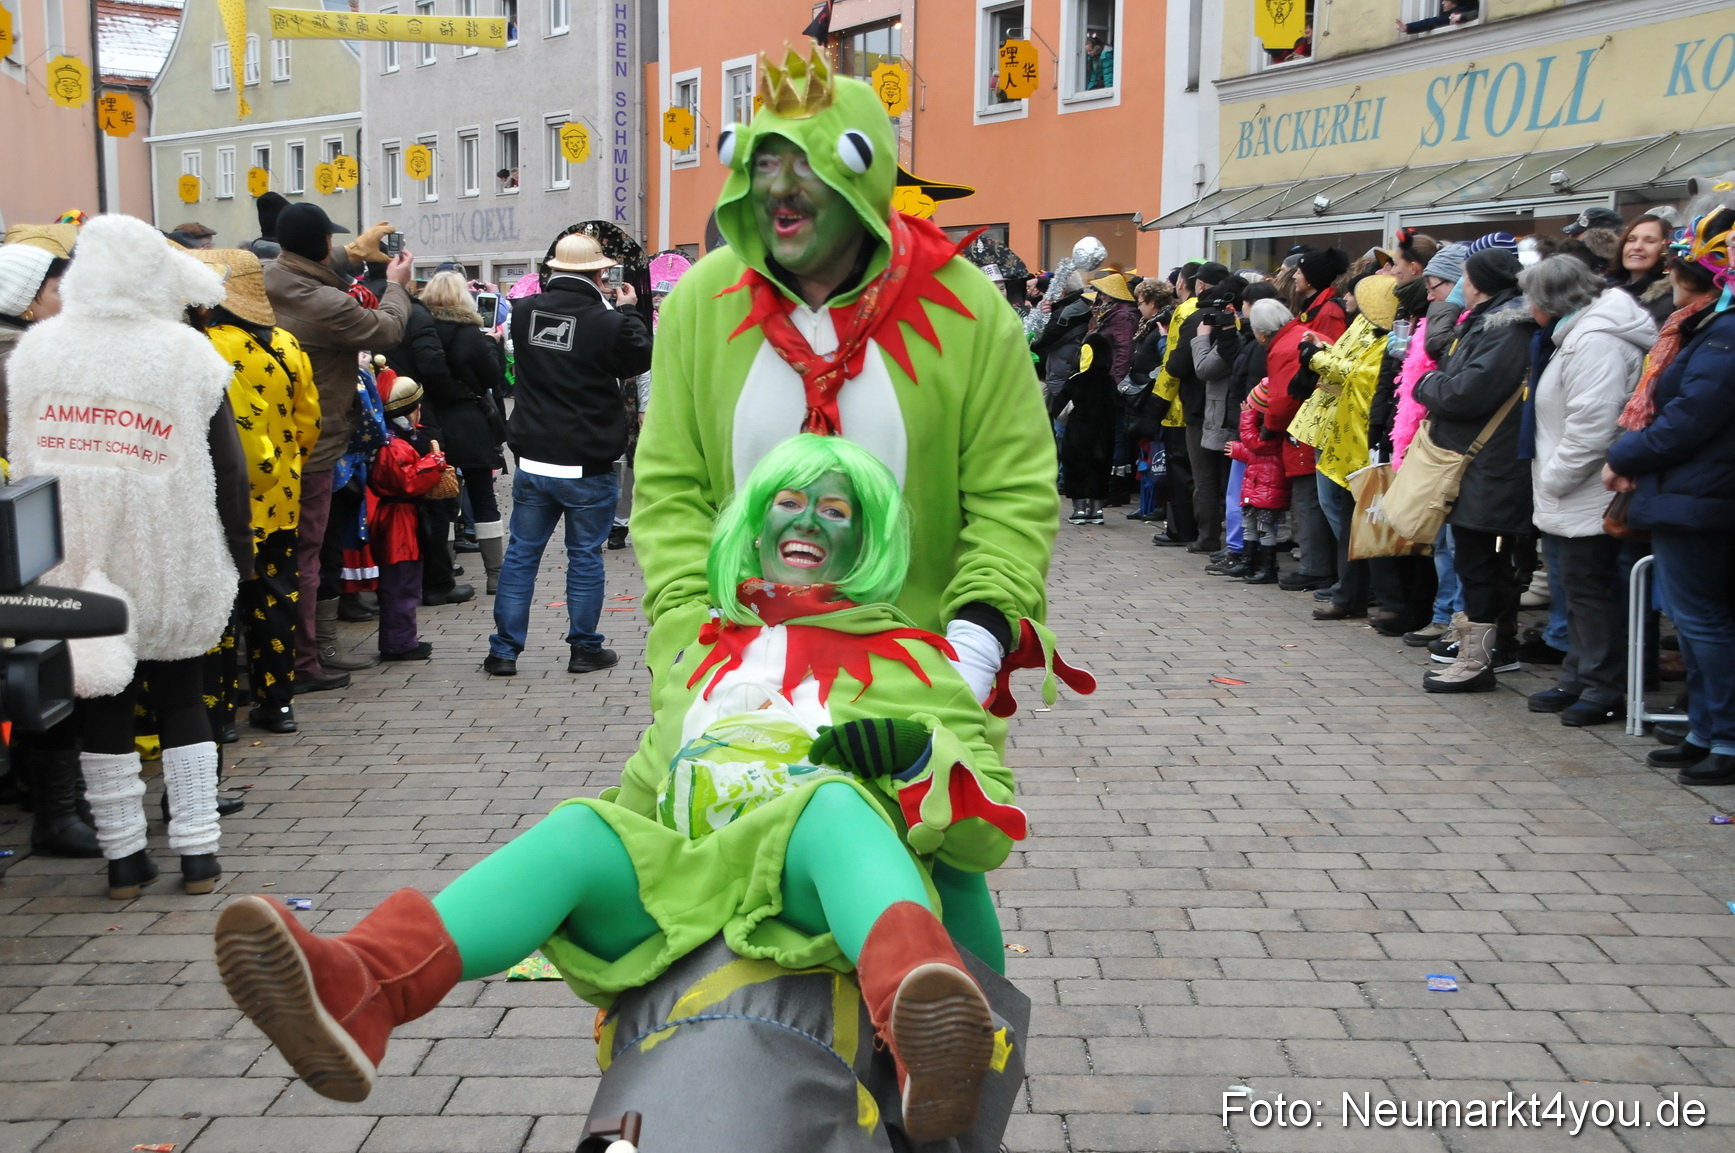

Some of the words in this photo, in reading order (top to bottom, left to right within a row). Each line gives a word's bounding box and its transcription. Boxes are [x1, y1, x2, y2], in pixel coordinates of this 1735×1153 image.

[1235, 96, 1387, 160] BÄCKEREI
[1419, 47, 1605, 149] STOLL
[613, 91, 629, 222] SCHMUCK
[418, 211, 468, 246] OPTIK
[470, 205, 521, 244] OEXL
[506, 267, 525, 277] BRILLEN
[39, 404, 174, 440] AMMFROMM
[37, 434, 65, 450] BER
[69, 438, 103, 453] ECHT
[105, 440, 169, 465] SCHA(R)F
